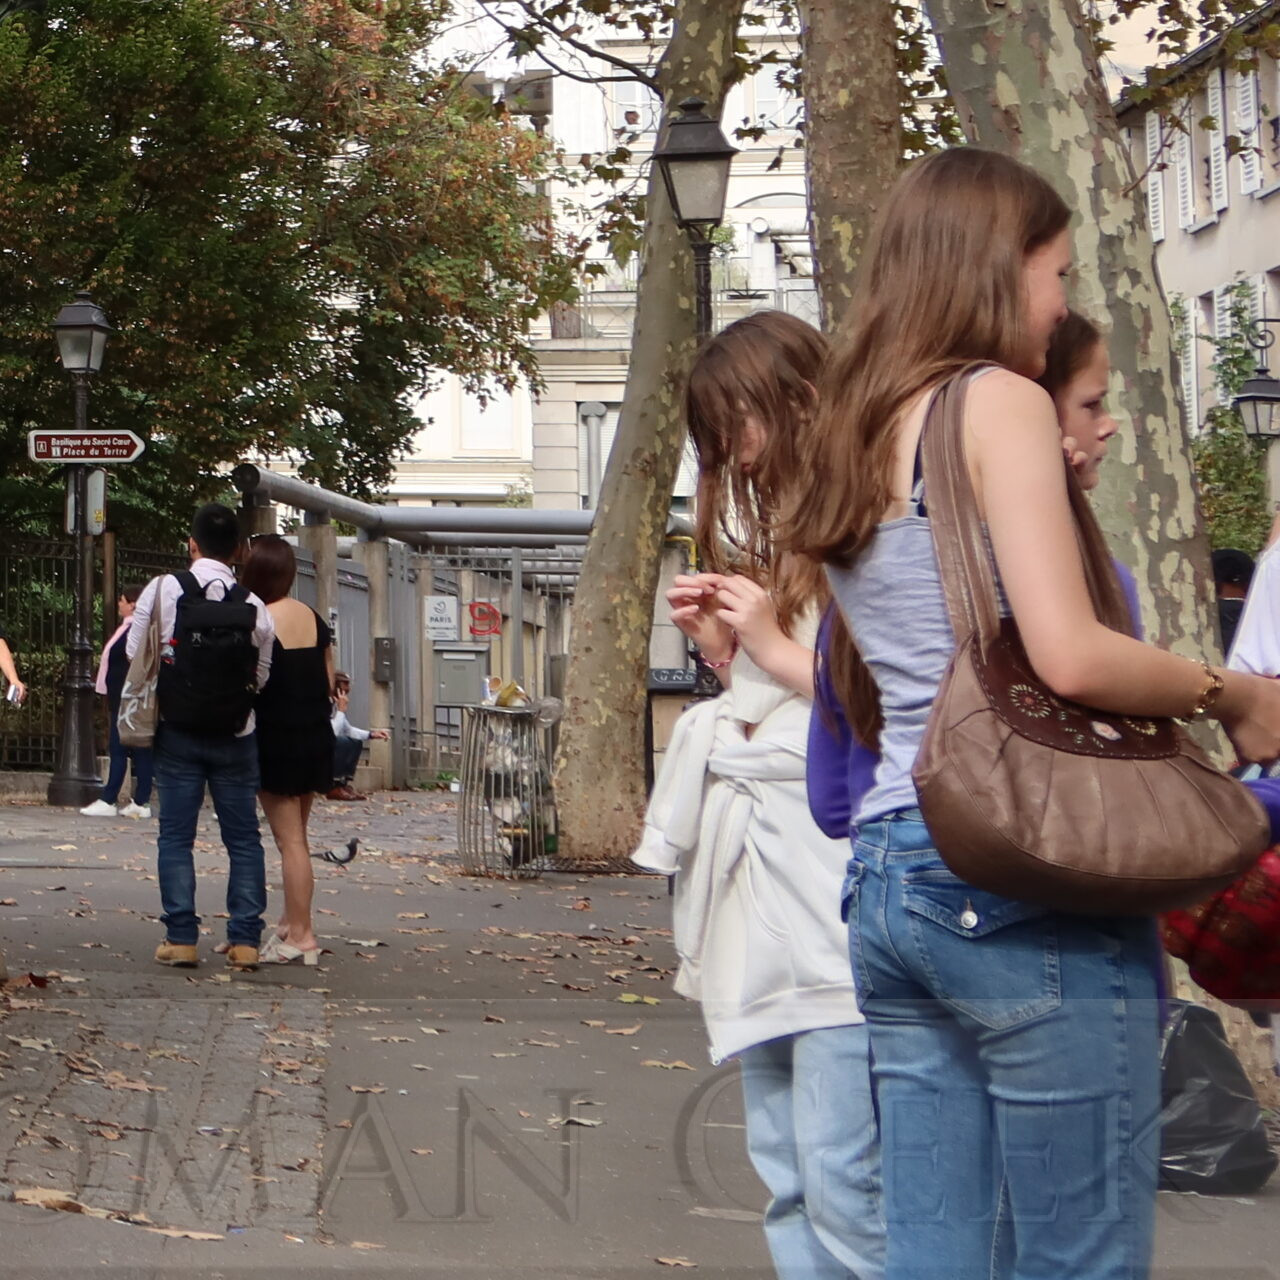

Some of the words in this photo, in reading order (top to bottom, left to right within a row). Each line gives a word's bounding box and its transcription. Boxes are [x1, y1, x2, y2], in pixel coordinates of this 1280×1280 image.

[51, 438, 81, 447] Basilique
[92, 437, 111, 445] Sacré
[63, 448, 86, 456] Place
[90, 448, 100, 456] du
[104, 448, 128, 456] Tertre
